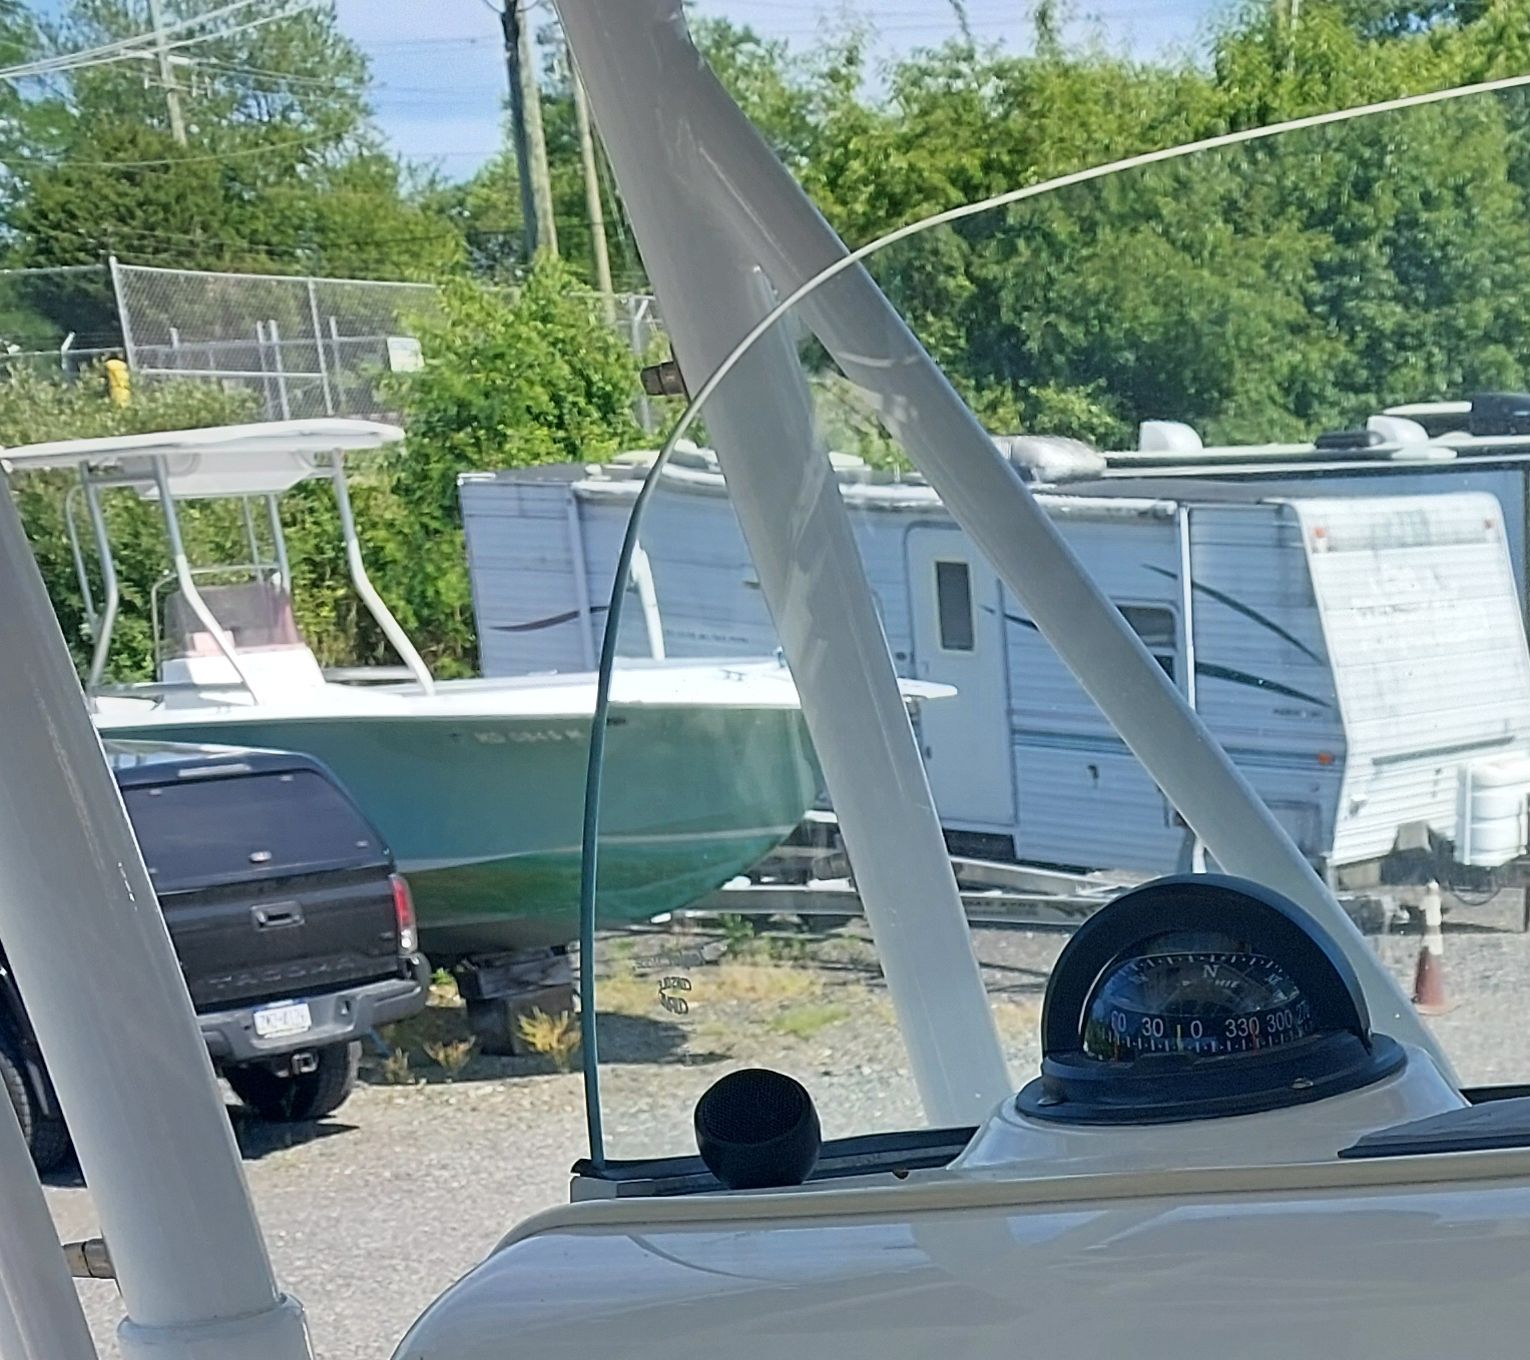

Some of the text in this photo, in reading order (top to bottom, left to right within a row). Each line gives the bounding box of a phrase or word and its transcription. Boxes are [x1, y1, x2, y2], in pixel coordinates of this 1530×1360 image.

[1142, 1017, 1164, 1038] 30
[1190, 1020, 1203, 1039] 0
[1225, 1017, 1260, 1038] 330
[1267, 1009, 1293, 1033] 300
